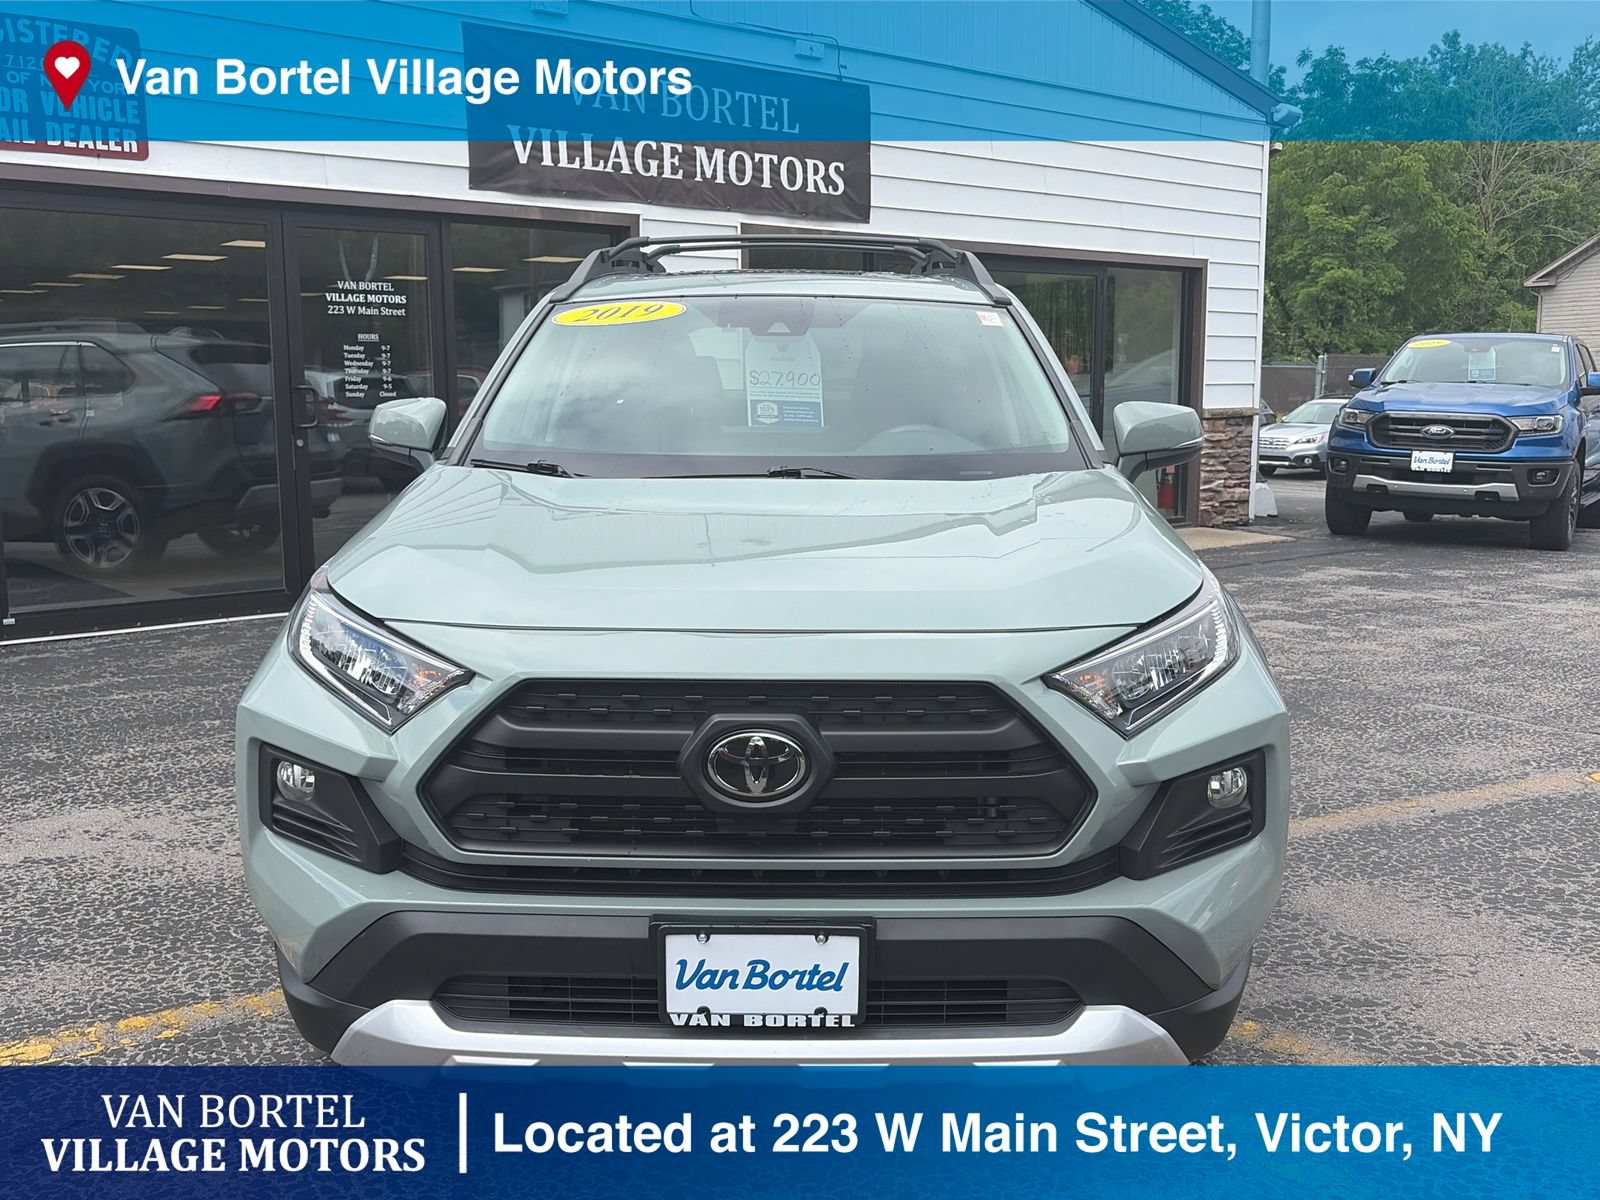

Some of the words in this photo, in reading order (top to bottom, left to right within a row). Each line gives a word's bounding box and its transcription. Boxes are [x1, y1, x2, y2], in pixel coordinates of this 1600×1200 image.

[658, 80, 800, 134] BORTEL
[46, 121, 138, 153] DEALER
[506, 124, 684, 180] VILLAGE
[693, 145, 846, 196] MOTORS
[337, 281, 357, 290] VAN
[359, 282, 394, 291] BORTEL
[325, 292, 366, 303] VILLAGE
[367, 294, 407, 304] MOTORS
[327, 305, 345, 315] 223
[346, 305, 356, 315] W
[358, 306, 379, 316] Main
[380, 306, 406, 316] Street
[572, 303, 666, 323] 2019
[357, 333, 380, 341] HOURS
[343, 344, 365, 352] Monday
[343, 352, 366, 360] Tuesday
[345, 383, 369, 391] Saturday
[669, 1013, 731, 1027] VAN
[743, 1014, 856, 1028] BORTEL
